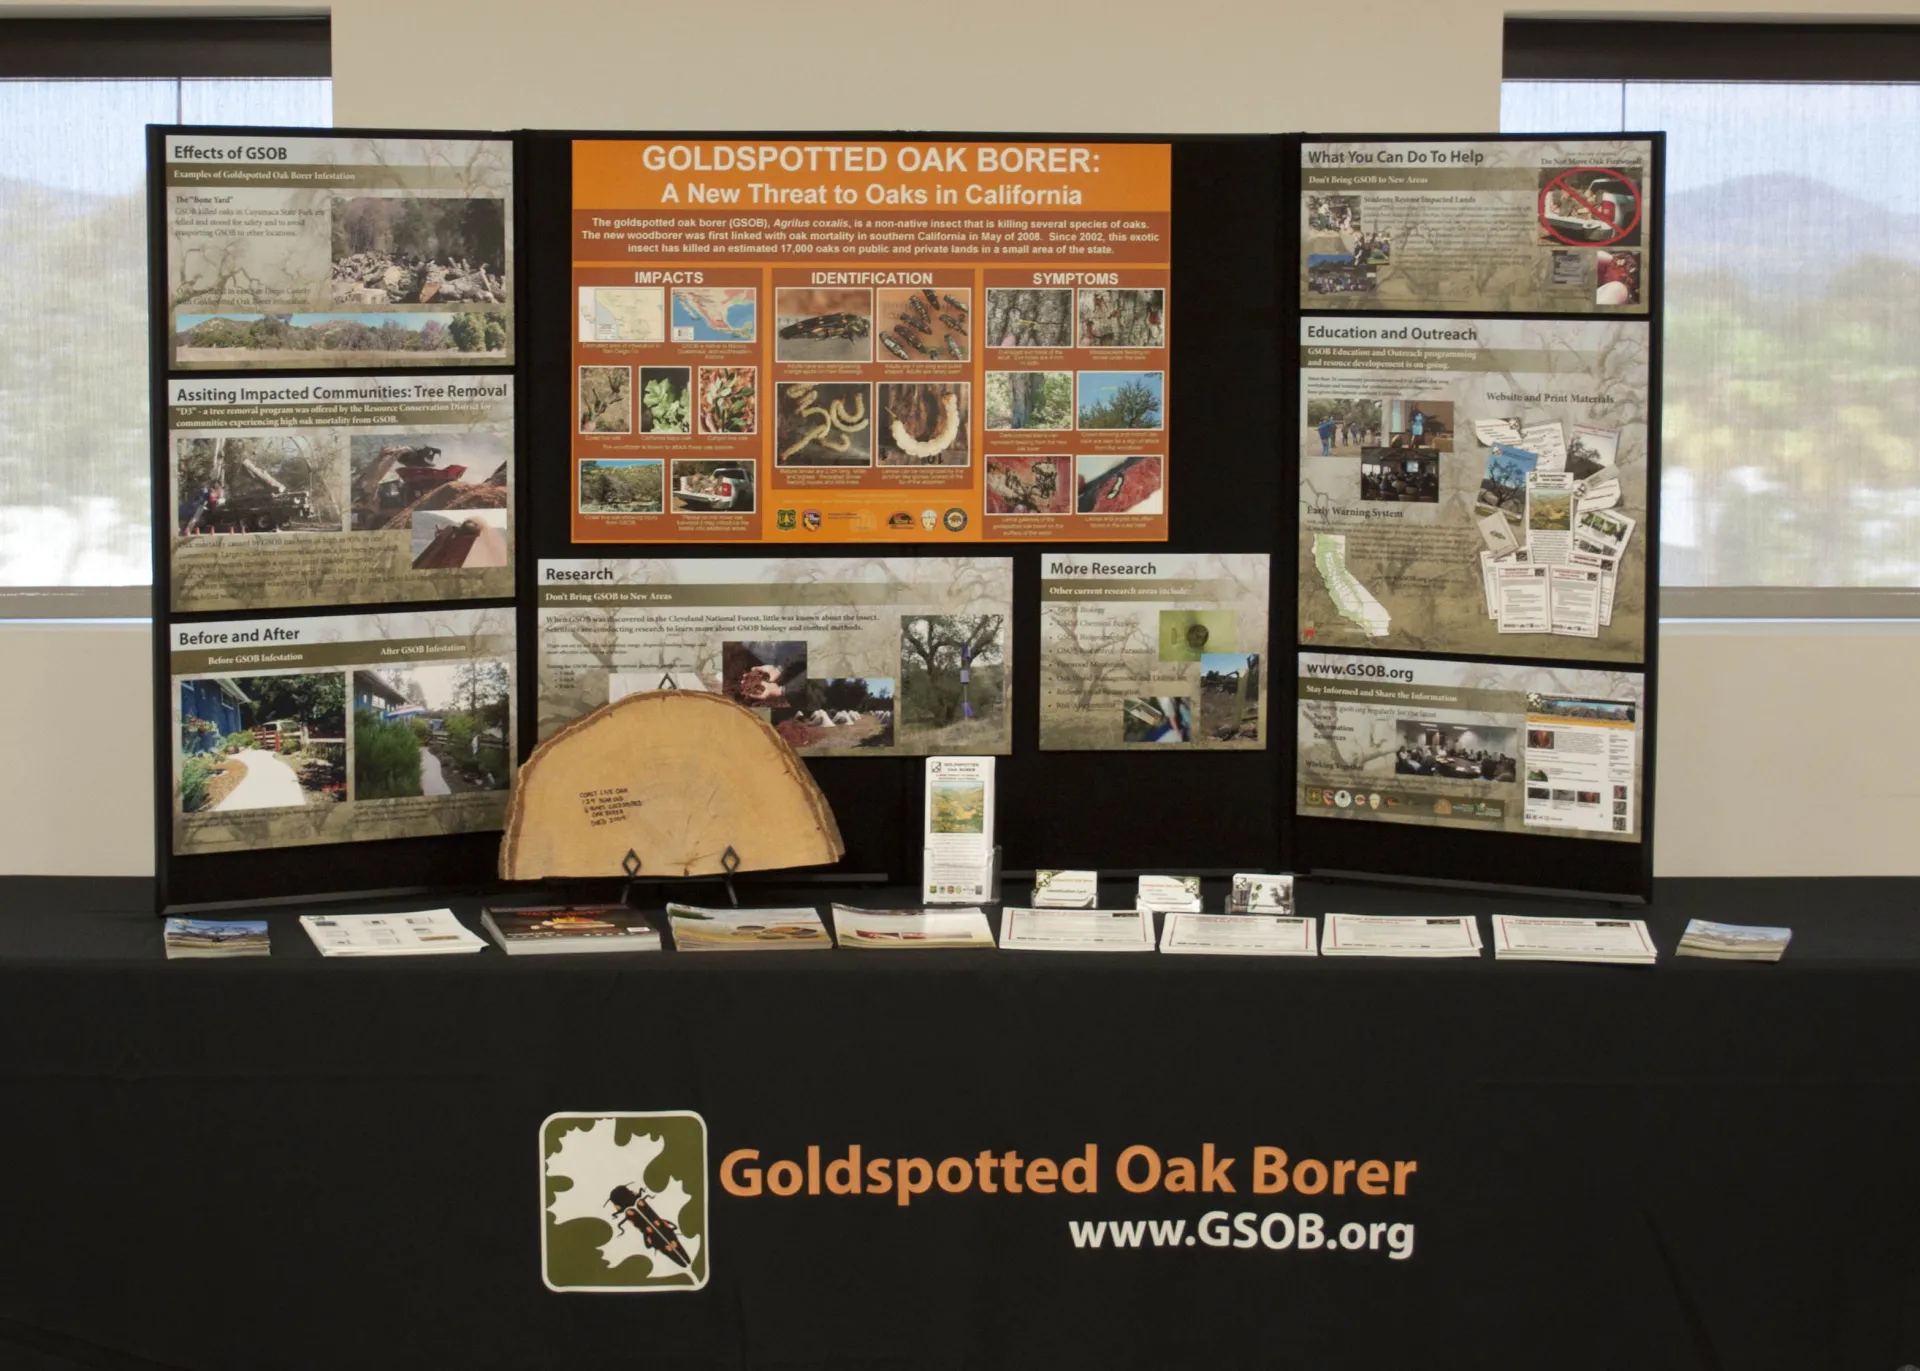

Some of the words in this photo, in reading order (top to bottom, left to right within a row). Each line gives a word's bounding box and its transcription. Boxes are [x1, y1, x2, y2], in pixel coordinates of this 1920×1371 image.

[174, 145, 224, 159] Effects
[227, 145, 243, 160] of
[245, 146, 287, 160] GSOB
[642, 145, 887, 171] GOLDSPOTTED
[897, 146, 967, 172] OAK
[977, 147, 1099, 173] BORER:
[1308, 150, 1345, 164] What
[1348, 150, 1373, 164] You
[1376, 150, 1404, 164] Can
[1407, 150, 1427, 163] Do
[1430, 150, 1447, 163] To
[1450, 149, 1484, 166] Help
[173, 169, 212, 180] Examples
[212, 170, 222, 178] of
[222, 170, 271, 181] Goldspotted
[272, 170, 289, 179] Oak
[290, 171, 312, 179] Borer
[314, 171, 355, 180] Infestation
[1331, 175, 1352, 185] Bring
[1353, 175, 1377, 183] GSOB
[1388, 175, 1404, 183] New
[660, 182, 679, 203] A
[688, 182, 740, 204] New
[747, 183, 827, 204] Threat
[833, 184, 858, 204] to
[865, 183, 928, 204] Oaks
[936, 184, 957, 204] in
[965, 183, 1082, 205] California
[591, 217, 611, 227] The
[613, 217, 675, 229] goldspotted
[677, 218, 696, 227] oak
[699, 218, 727, 227] borer
[728, 217, 770, 229] (GSOB),
[773, 218, 810, 230] Agrilus
[812, 218, 851, 228] coxalis,
[853, 219, 863, 228] is
[865, 220, 872, 228] a
[874, 219, 928, 228] non-native
[930, 219, 962, 228] insect
[963, 219, 984, 228] that
[985, 219, 995, 228] is
[997, 219, 1028, 230] killing
[1030, 219, 1067, 228] several
[1069, 220, 1108, 230] species
[1110, 219, 1121, 229] of
[1122, 220, 1149, 229] oaks.
[581, 230, 601, 240] The
[603, 231, 625, 239] new
[626, 230, 683, 240] woodborer
[684, 232, 706, 240] was
[708, 230, 729, 240] first
[731, 230, 762, 240] linked
[764, 231, 786, 240] with
[788, 231, 808, 240] oak
[809, 231, 855, 242] mortality
[857, 231, 867, 240] in
[869, 232, 915, 241] southern
[917, 231, 966, 241] California
[968, 231, 978, 241] in
[981, 231, 1002, 243] May
[1003, 231, 1015, 241] of
[1016, 231, 1043, 241] 2008.
[1048, 231, 1077, 241] Since
[1079, 232, 1105, 242] 2002,
[1108, 232, 1127, 242] this
[1129, 232, 1159, 241] exotic
[627, 243, 659, 253] insect
[661, 243, 680, 252] has
[682, 243, 710, 252] killed
[727, 243, 778, 253] estimated
[780, 243, 813, 253] 17,000
[815, 244, 840, 253] oaks
[842, 245, 856, 253] on
[858, 244, 889, 255] public
[892, 244, 912, 253] and
[913, 244, 949, 255] private
[950, 244, 979, 254] lands
[981, 244, 991, 254] in
[993, 246, 1000, 254] a
[1001, 244, 1029, 254] small
[1031, 246, 1054, 254] area
[1055, 244, 1067, 254] of
[1068, 244, 1085, 254] the
[1087, 245, 1114, 254] state.
[634, 271, 704, 284] IMPACTS
[811, 271, 933, 285] IDENTIFICATION
[1032, 272, 1119, 285] SYMPTOMS
[1307, 325, 1377, 339] Education
[1380, 326, 1408, 339] and
[1411, 327, 1477, 341] Outreach
[177, 388, 237, 405] Assiting
[240, 386, 309, 403] Impacted
[312, 386, 412, 400] Communities:
[413, 385, 445, 398] Tree
[447, 383, 507, 397] Removal
[1486, 391, 1523, 401] Website
[1523, 392, 1542, 402] and
[1543, 393, 1568, 403] Print
[1570, 393, 1614, 404] Materials
[1306, 505, 1329, 517] Early
[1332, 506, 1371, 519] Warning
[1371, 508, 1404, 519] System
[546, 567, 614, 580] Research
[1050, 562, 1088, 575] More
[1091, 562, 1156, 575] Research
[569, 592, 592, 602] Bring
[593, 592, 619, 600] GSOB
[630, 592, 647, 600] New
[650, 592, 672, 600] Areas
[1049, 586, 1073, 595] Other
[1074, 587, 1103, 595] current
[1104, 587, 1136, 595] research
[1158, 587, 1190, 596] include:
[179, 631, 228, 646] Before
[231, 629, 260, 643] and
[263, 627, 300, 642] After
[380, 646, 400, 655] After
[400, 645, 424, 654] GSOB
[425, 643, 466, 653] Infestation
[208, 655, 234, 665] Before
[234, 654, 260, 663] GSOB
[261, 652, 303, 662] Infestation
[1306, 664, 1414, 682] www.GSOB.org
[1306, 684, 1321, 695] Stay
[1323, 685, 1359, 696] Informed
[1359, 688, 1374, 697] and
[1374, 689, 1396, 698] Share
[1397, 690, 1409, 699] the
[1411, 691, 1457, 702] Information
[719, 1144, 1097, 1206] Goldspotted
[1116, 1143, 1235, 1193] Oak
[1252, 1146, 1417, 1195] Borer
[1068, 1211, 1414, 1258] www.GSOB.org
